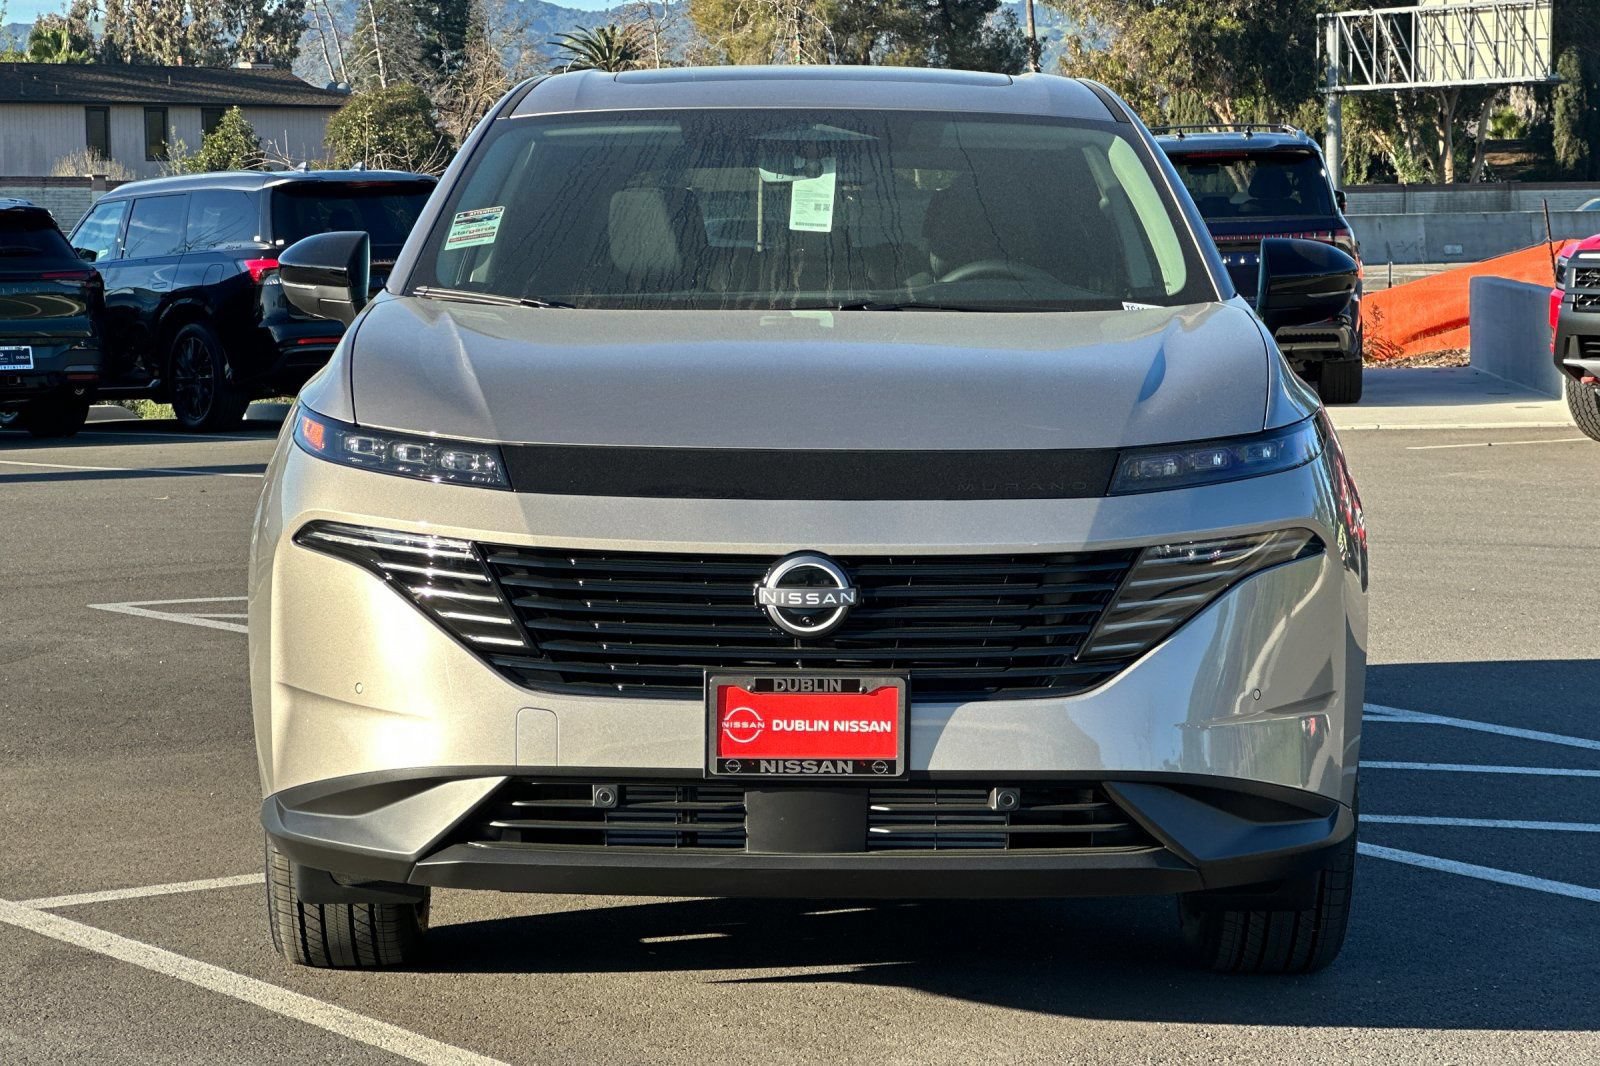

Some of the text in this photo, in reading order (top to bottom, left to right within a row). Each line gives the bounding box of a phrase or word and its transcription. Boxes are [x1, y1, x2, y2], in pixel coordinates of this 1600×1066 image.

[957, 480, 1087, 491] MURANO
[761, 590, 855, 605] NISSAN
[773, 678, 842, 693] DUBLIN
[722, 721, 765, 729] NISSAN
[772, 719, 892, 733] DUBLIN NISSAN
[760, 760, 853, 774] NISSAN
